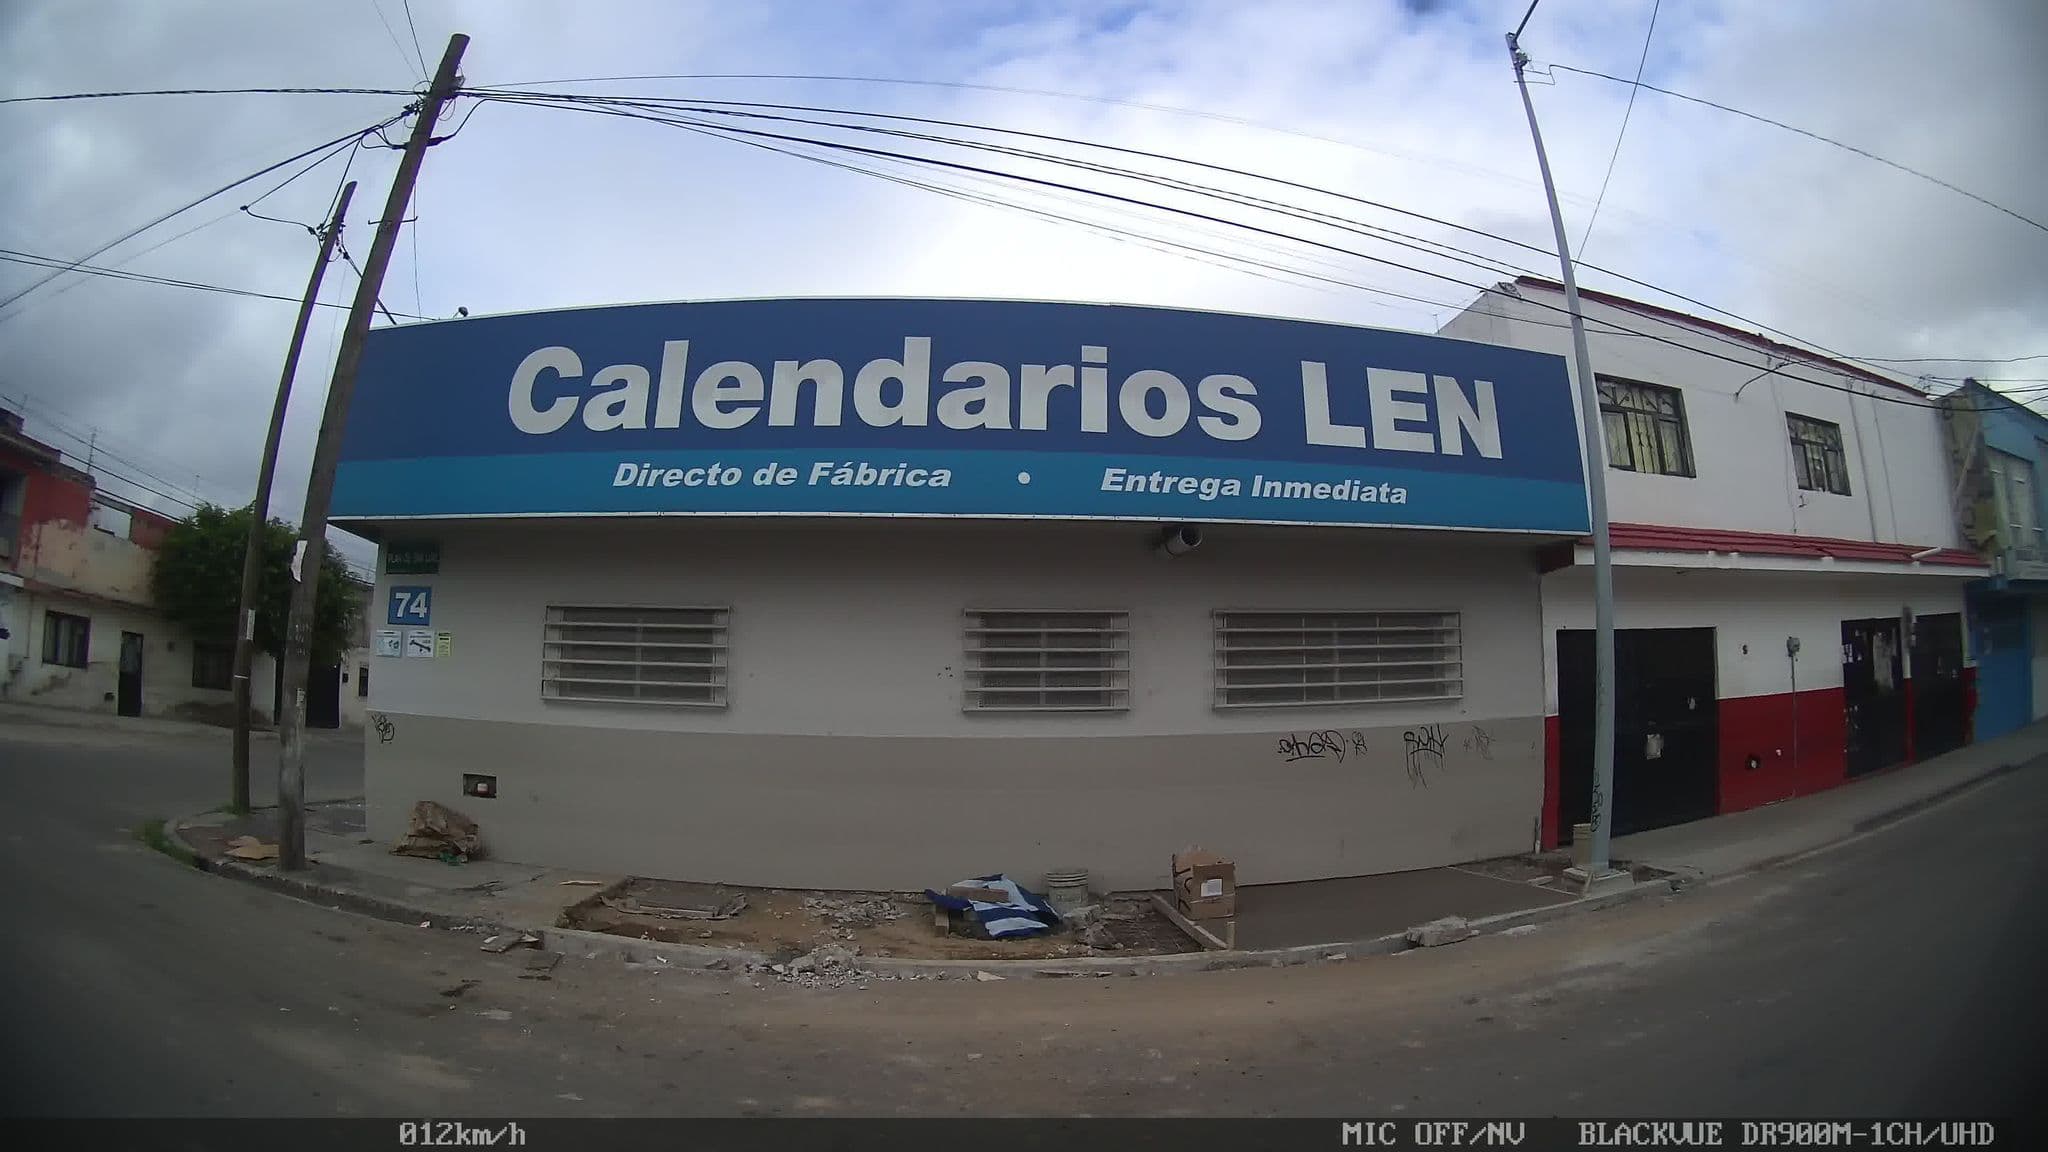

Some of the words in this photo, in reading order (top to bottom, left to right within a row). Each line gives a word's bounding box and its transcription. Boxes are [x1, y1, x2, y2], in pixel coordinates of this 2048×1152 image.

[508, 336, 1262, 441] Calendarios
[1300, 360, 1504, 460] LEN
[612, 461, 742, 488] Directo
[753, 462, 798, 487] de
[807, 460, 952, 488] Fábrica
[1101, 468, 1241, 501] Entrega
[1251, 475, 1407, 505] Inmediata
[395, 592, 428, 618] 74
